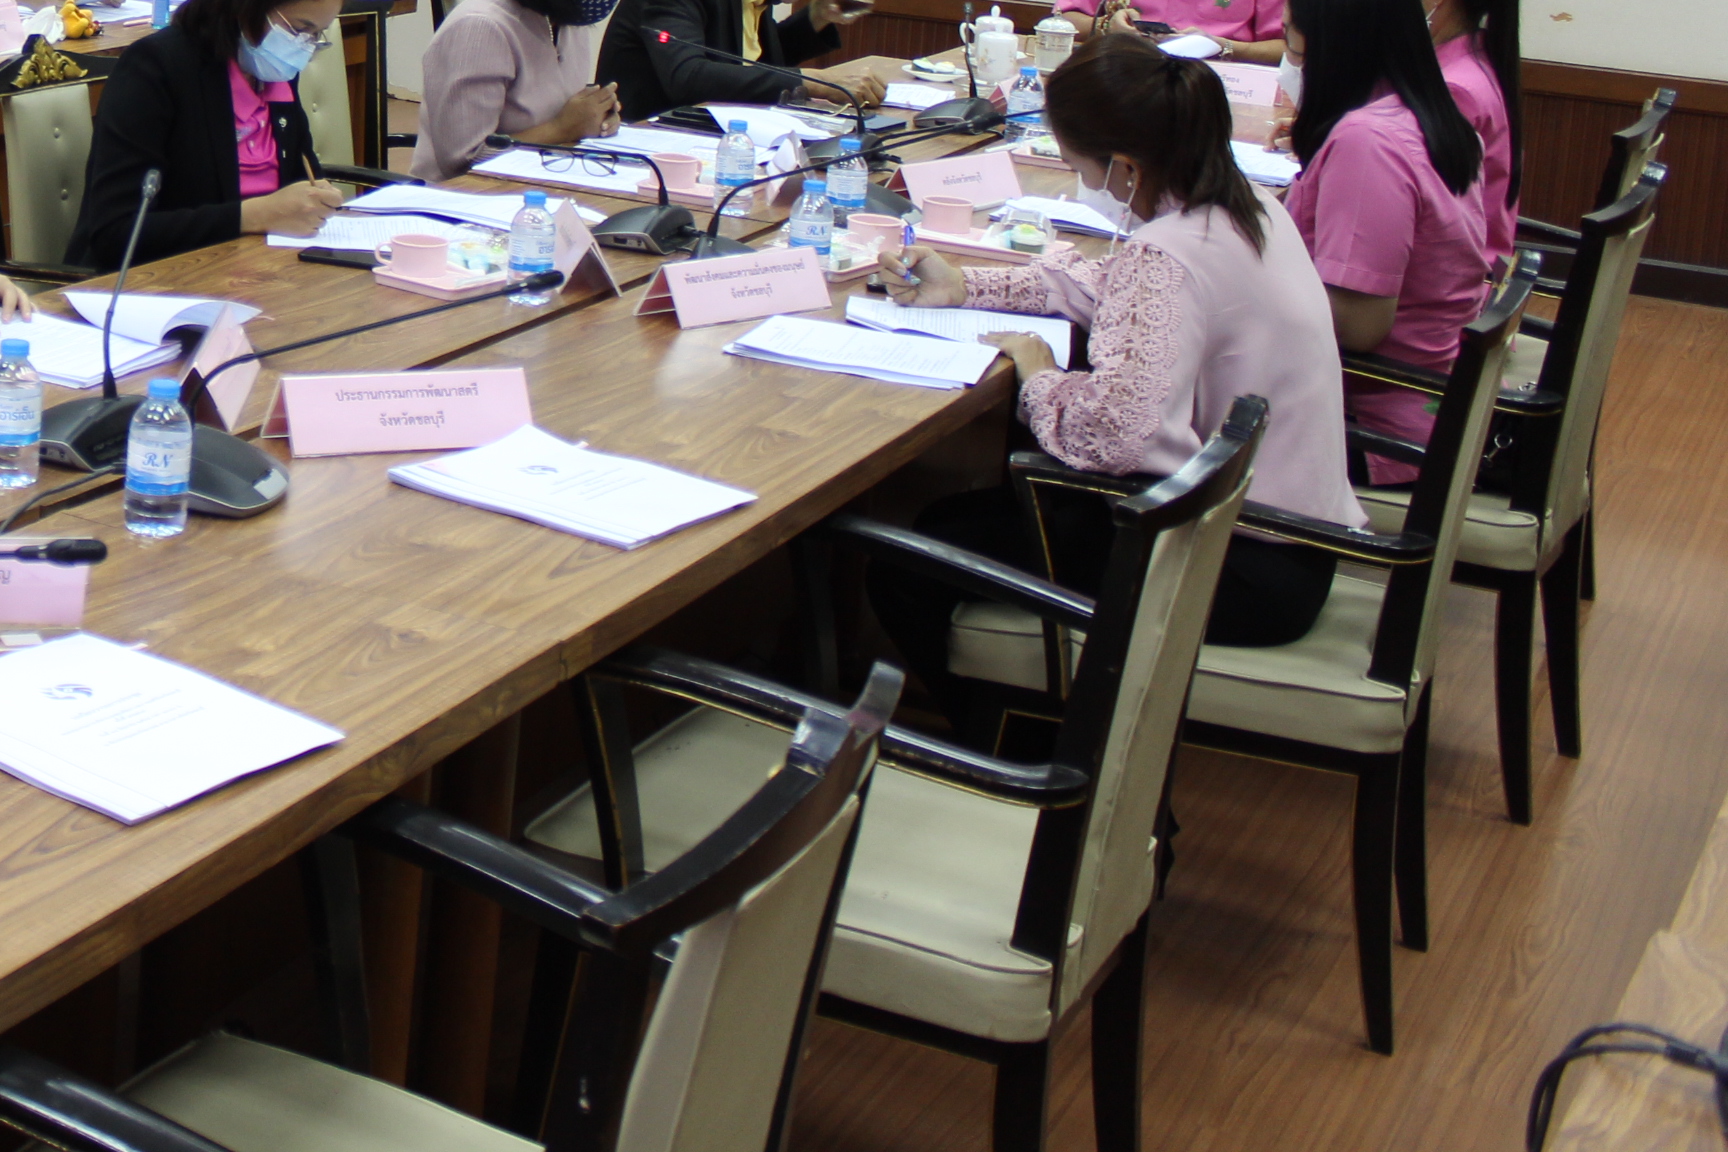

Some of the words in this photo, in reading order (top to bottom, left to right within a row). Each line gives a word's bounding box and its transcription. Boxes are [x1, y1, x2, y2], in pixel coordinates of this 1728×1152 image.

[335, 383, 479, 402] ประธานกรรมการพัฒนาสตรี
[379, 410, 445, 428] จังหวัดชลบุรี
